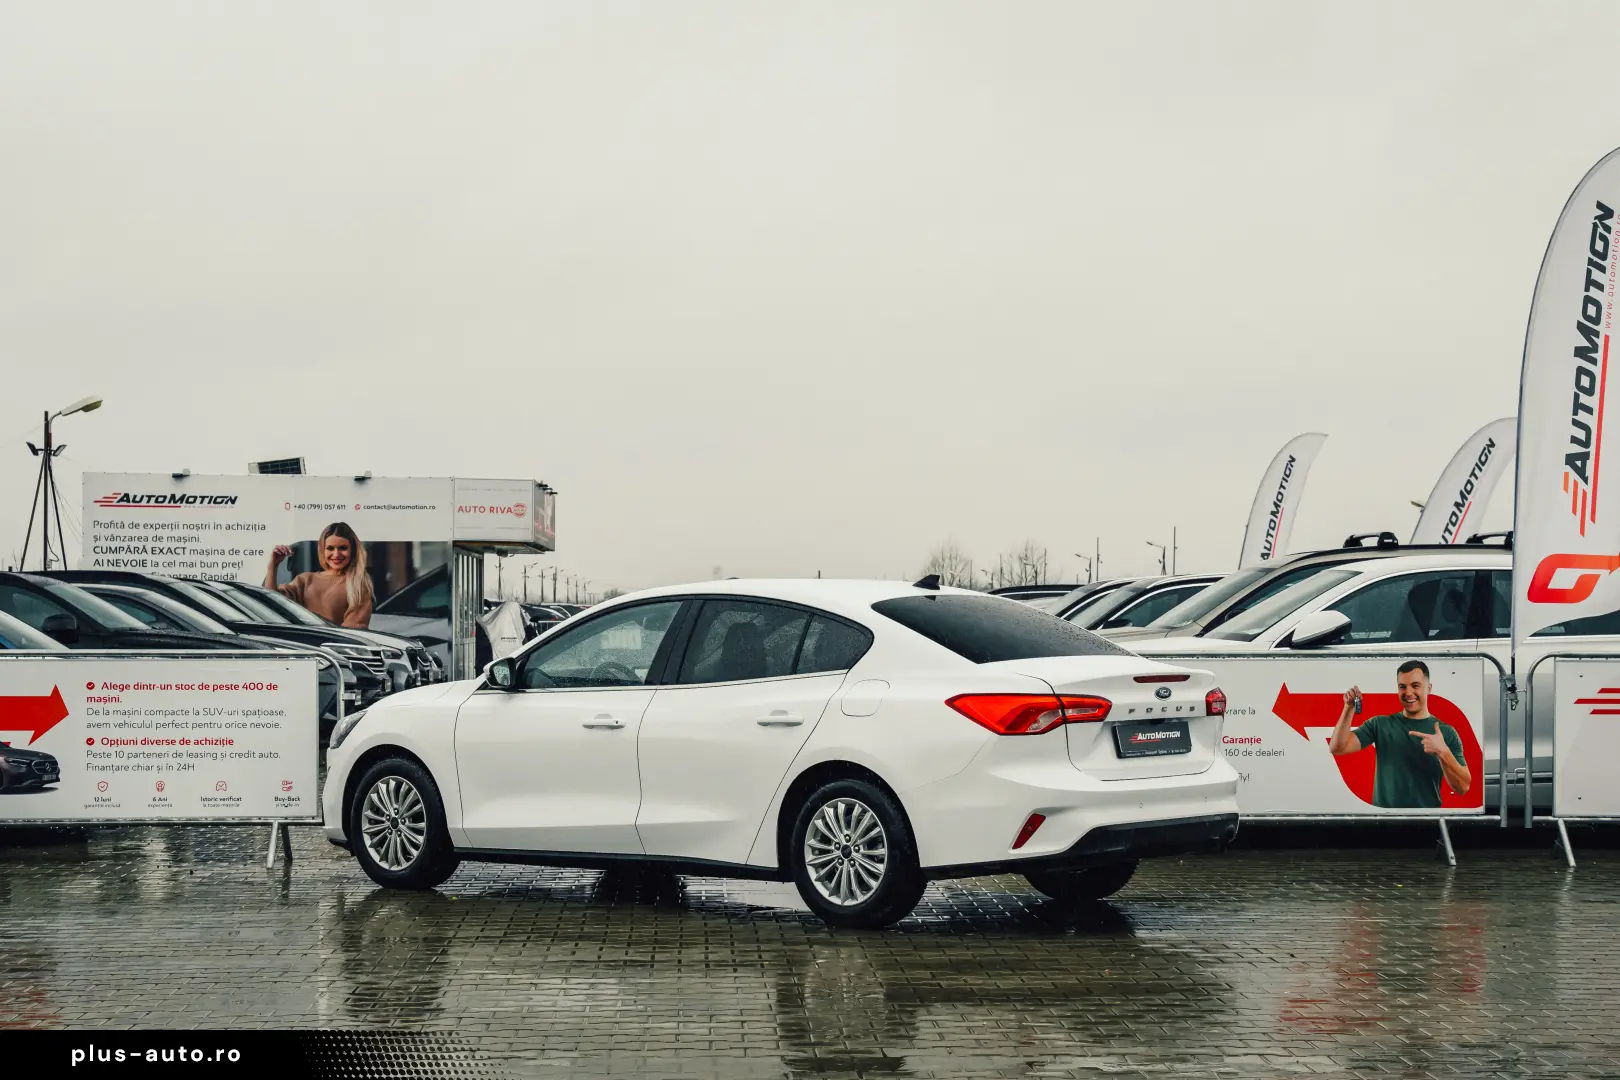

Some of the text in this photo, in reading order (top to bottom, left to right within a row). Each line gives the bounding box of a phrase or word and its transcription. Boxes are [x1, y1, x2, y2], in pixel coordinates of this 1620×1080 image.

[1438, 437, 1496, 544] UTOMOTION
[116, 492, 238, 505] AUTOMOTION
[489, 506, 513, 514] RIVA
[128, 520, 140, 529] de
[213, 521, 222, 530] în
[152, 533, 164, 542] de
[151, 546, 187, 555] EXACT
[190, 548, 225, 557] mașina
[228, 547, 240, 555] de
[243, 548, 264, 556] care
[93, 558, 104, 567] AI
[107, 558, 147, 567] NEVOIE
[151, 559, 159, 567] la
[162, 559, 175, 568] cel
[179, 559, 196, 568] mai
[200, 559, 218, 568] bun
[101, 682, 130, 692] Alege
[133, 681, 172, 690] dintr-un
[198, 681, 210, 690] de
[213, 683, 239, 692] peste
[242, 682, 263, 690] 400
[266, 682, 278, 690] de
[87, 707, 100, 715] De
[103, 706, 110, 715] la
[113, 708, 141, 718] mașini
[144, 708, 189, 717] compacte
[203, 707, 238, 716] SUV-uri
[1128, 706, 1196, 714] FOCUS
[113, 719, 152, 728] vehiculul
[156, 720, 189, 730] perfect
[192, 721, 222, 730] pentru
[225, 720, 247, 728] orice
[250, 720, 281, 728] nevoie.
[141, 736, 176, 745] diverse
[179, 736, 191, 745] de
[1222, 736, 1261, 746] Garanție
[87, 749, 112, 758] Peste
[115, 749, 124, 758] 10
[127, 751, 169, 760] parteneri
[172, 749, 183, 758] de
[186, 750, 217, 760] leasing
[230, 749, 256, 758] credit
[259, 750, 280, 758] auto.
[1225, 747, 1284, 756] 160 de dealeri
[132, 762, 154, 771] chiar
[177, 762, 194, 771] 24H
